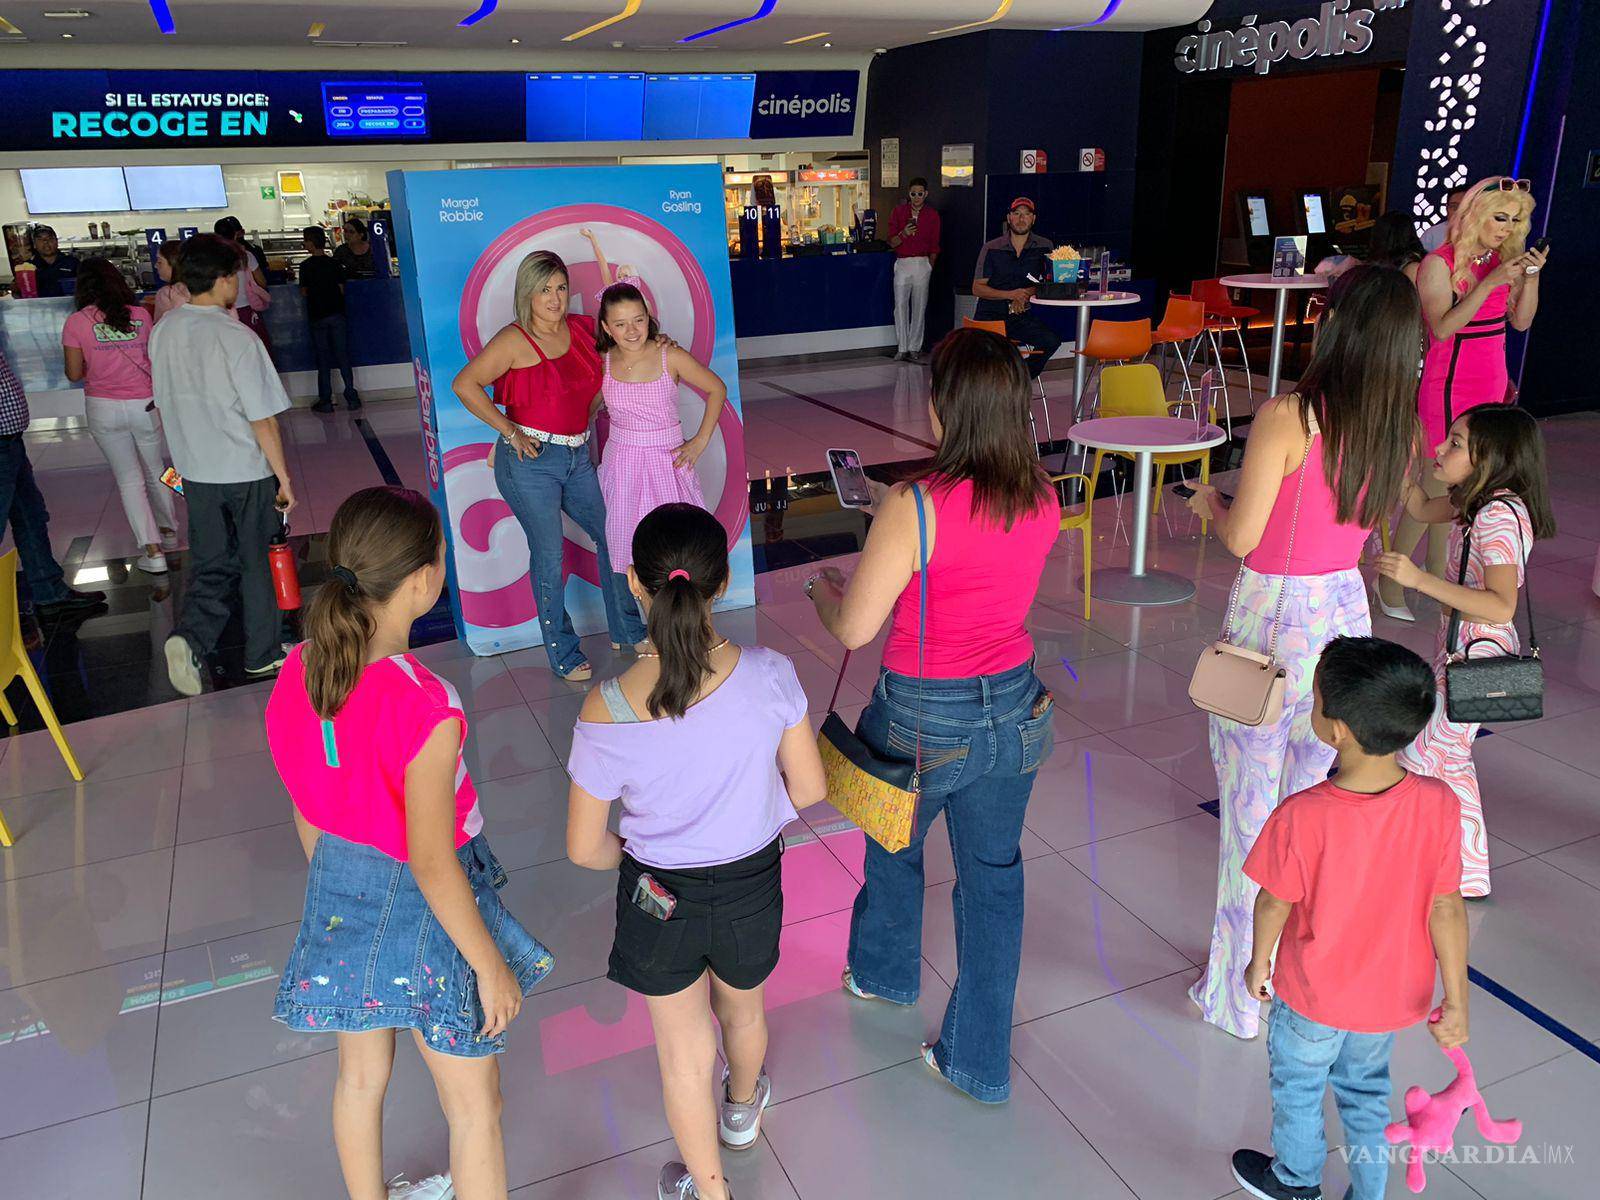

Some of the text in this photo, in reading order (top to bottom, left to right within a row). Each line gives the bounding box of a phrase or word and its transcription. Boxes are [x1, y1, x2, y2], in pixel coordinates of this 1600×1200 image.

[1174, 0, 1374, 75] cinépolis
[105, 93, 270, 107] SI EL ESTATUS DICE:
[758, 92, 852, 118] cinépolis
[52, 110, 269, 138] RECOGE EN
[669, 189, 692, 201] Ryan
[441, 197, 479, 211] Margot
[661, 200, 702, 215] Gosling
[439, 209, 485, 223] Robbie
[744, 207, 758, 220] 10
[767, 206, 780, 220] 11
[372, 221, 384, 236] 6
[151, 230, 163, 246] 4
[415, 357, 439, 484] Barbie
